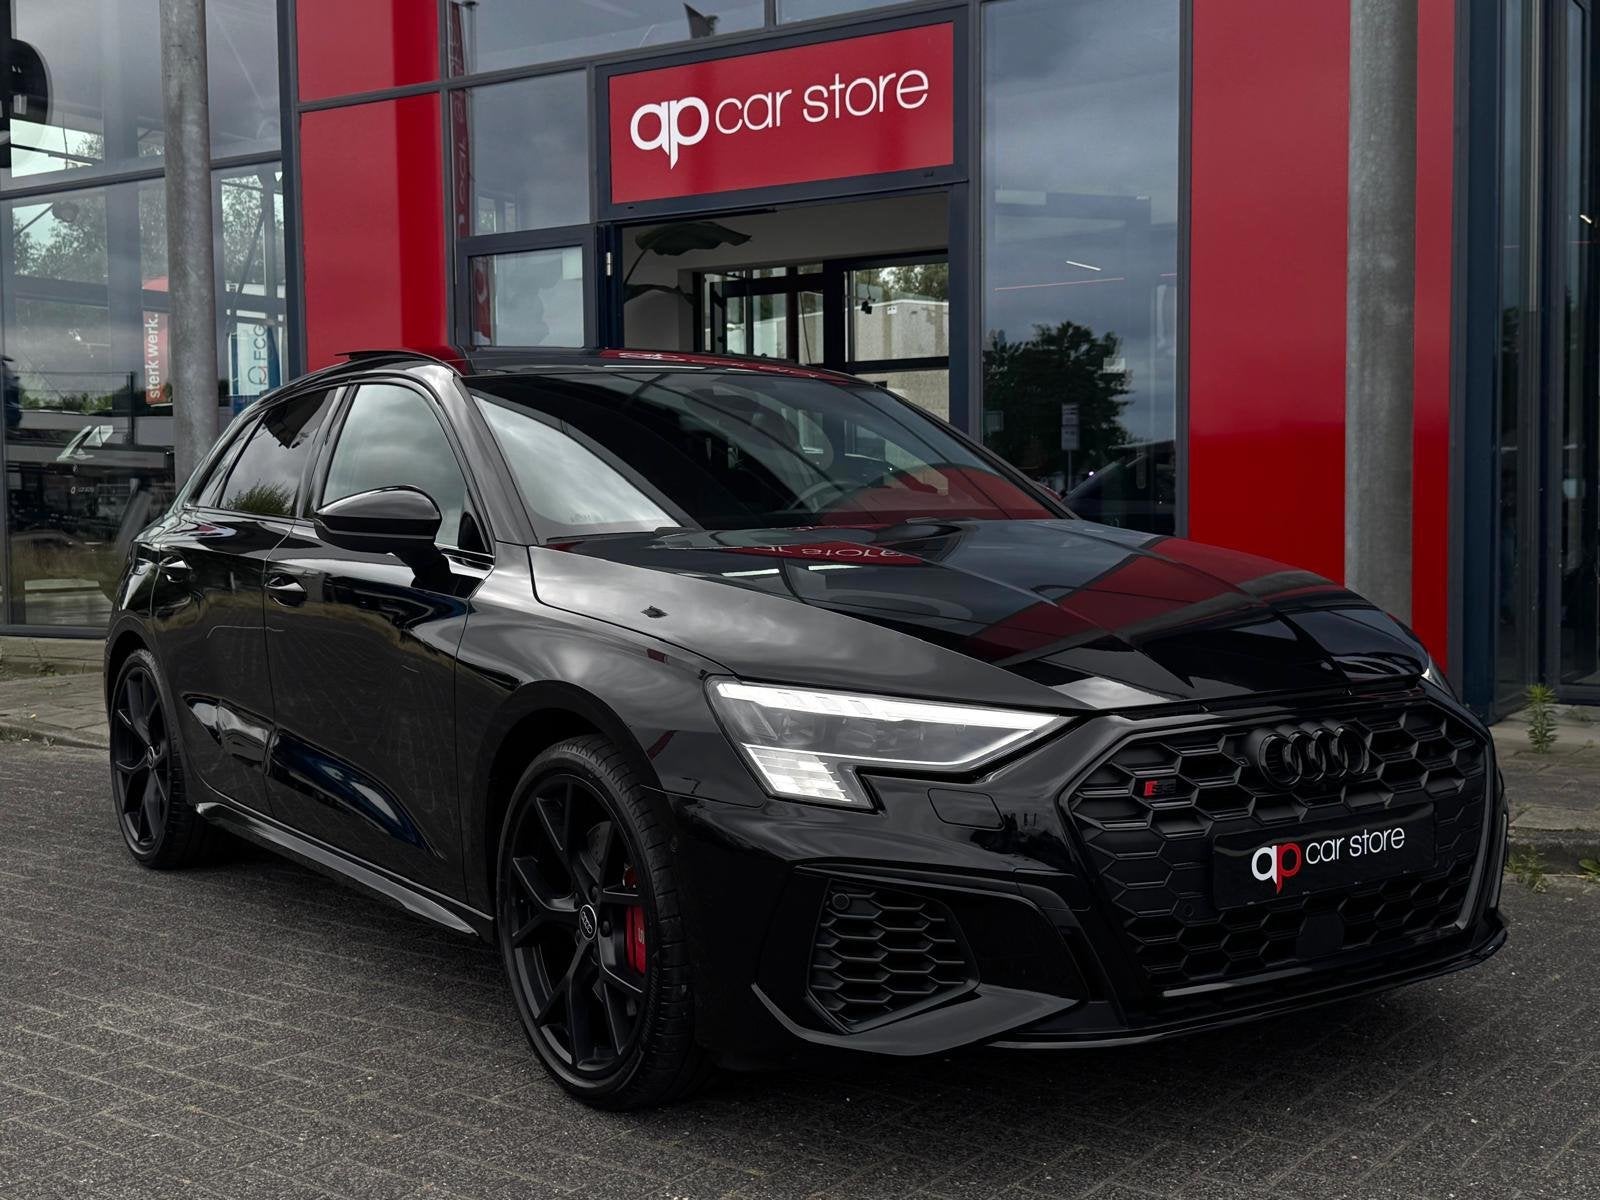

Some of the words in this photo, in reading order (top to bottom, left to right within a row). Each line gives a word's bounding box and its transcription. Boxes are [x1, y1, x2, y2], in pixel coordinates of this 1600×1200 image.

[715, 89, 792, 134] car
[803, 69, 928, 123] store
[144, 313, 160, 359] werk.
[144, 362, 160, 399] sterk
[1305, 837, 1345, 865] car
[1349, 827, 1405, 857] store
